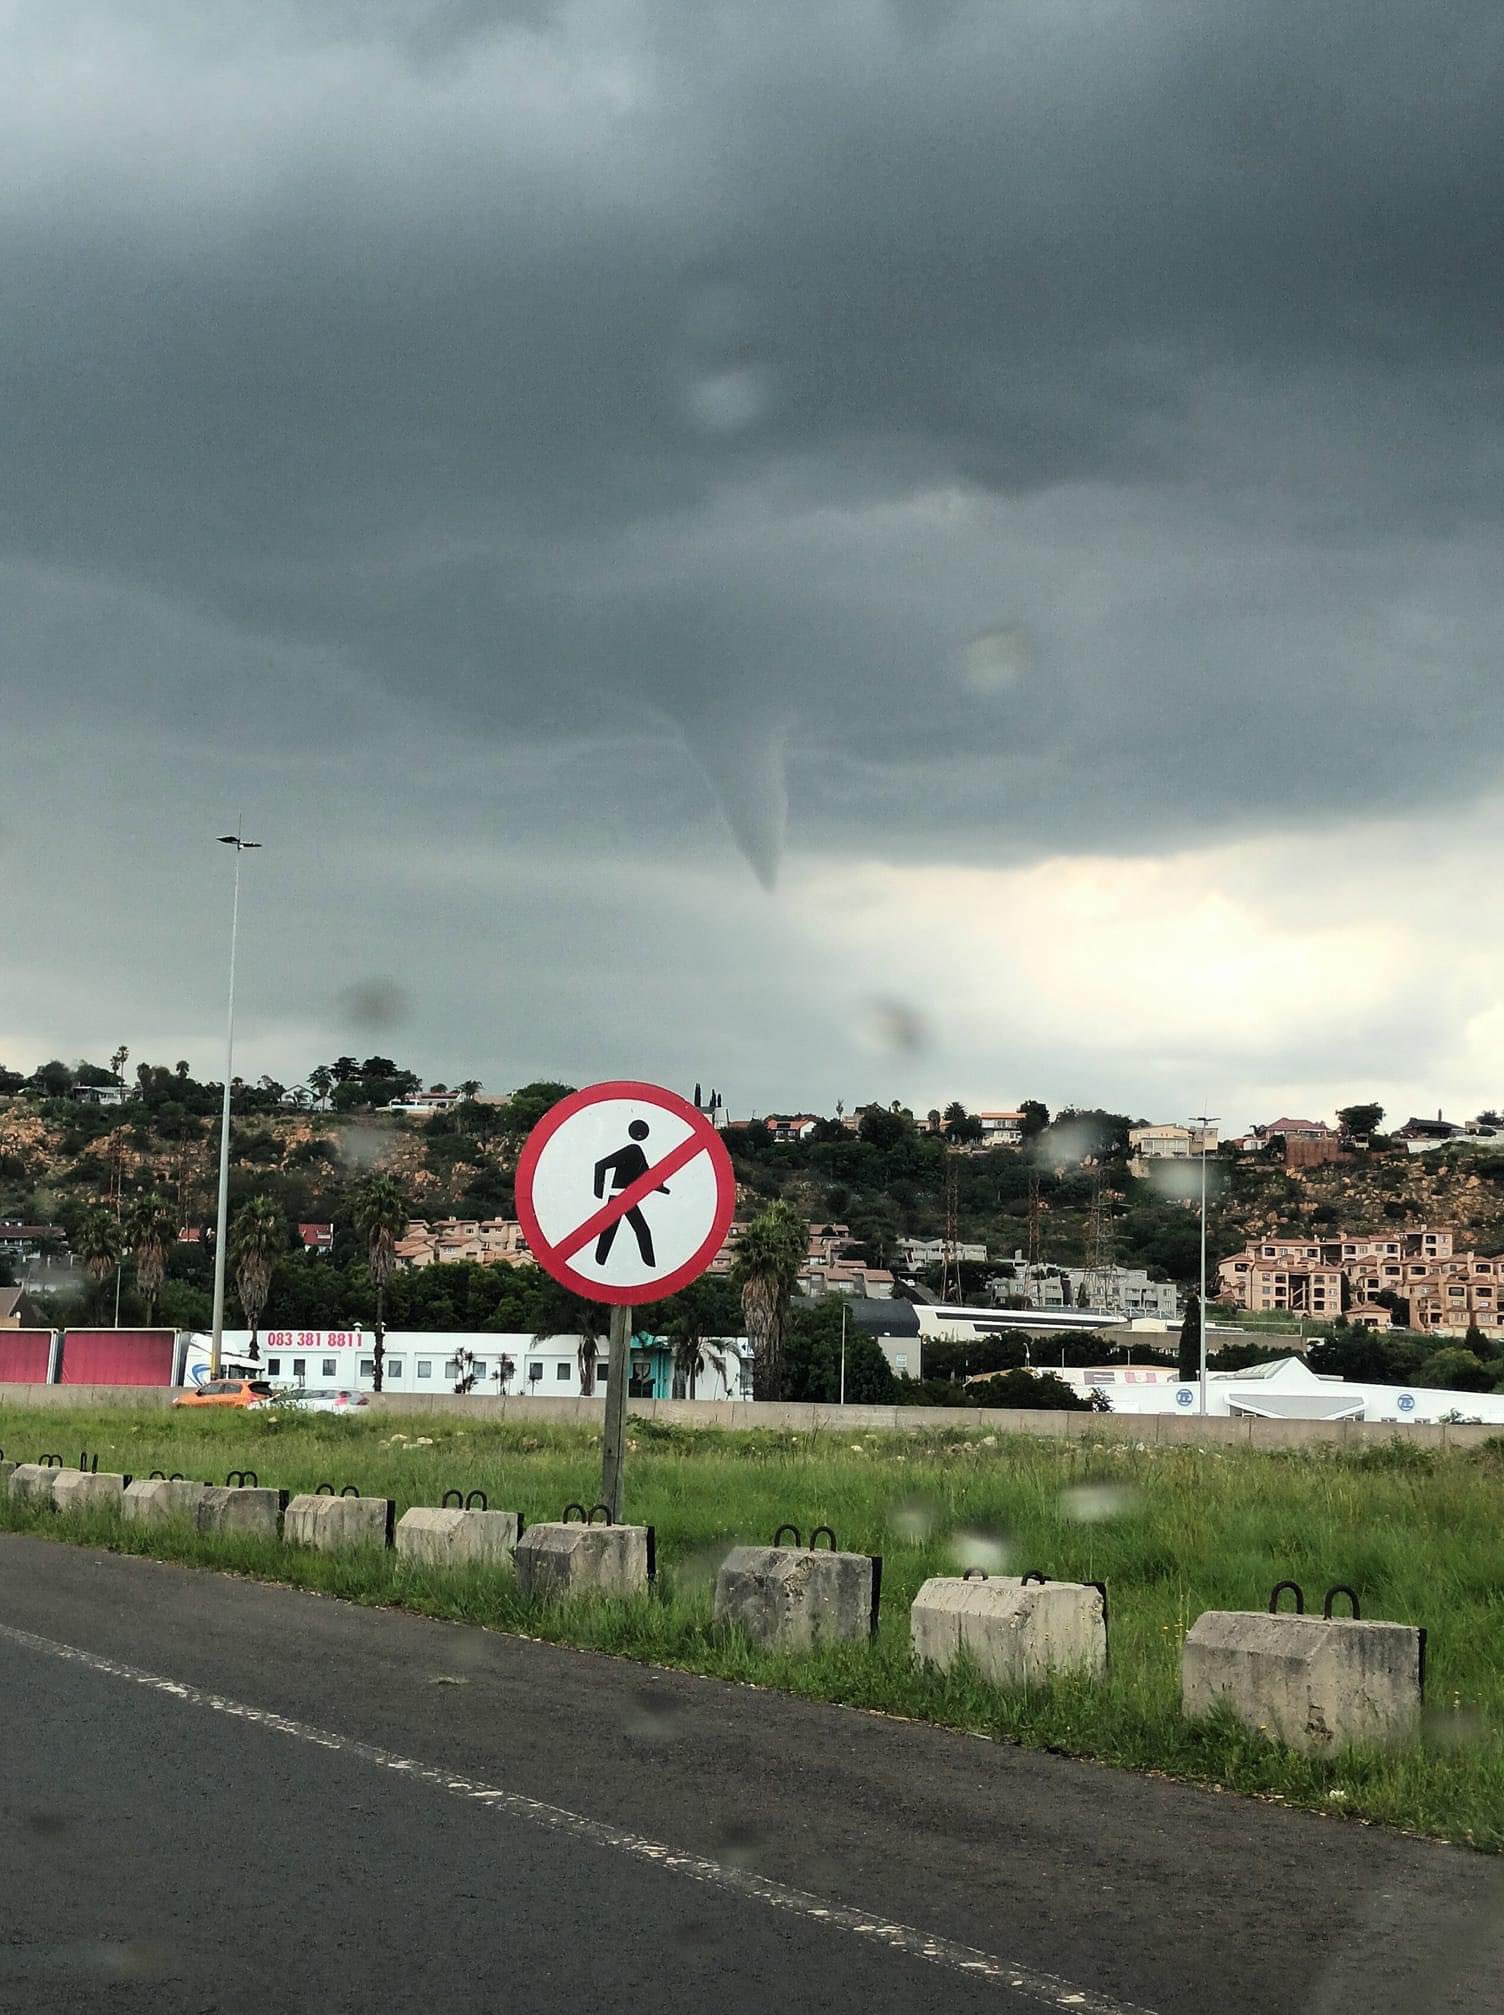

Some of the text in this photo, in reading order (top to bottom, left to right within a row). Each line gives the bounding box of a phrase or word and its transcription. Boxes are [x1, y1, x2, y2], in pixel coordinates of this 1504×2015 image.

[268, 1332, 362, 1347] 083 381 8811
